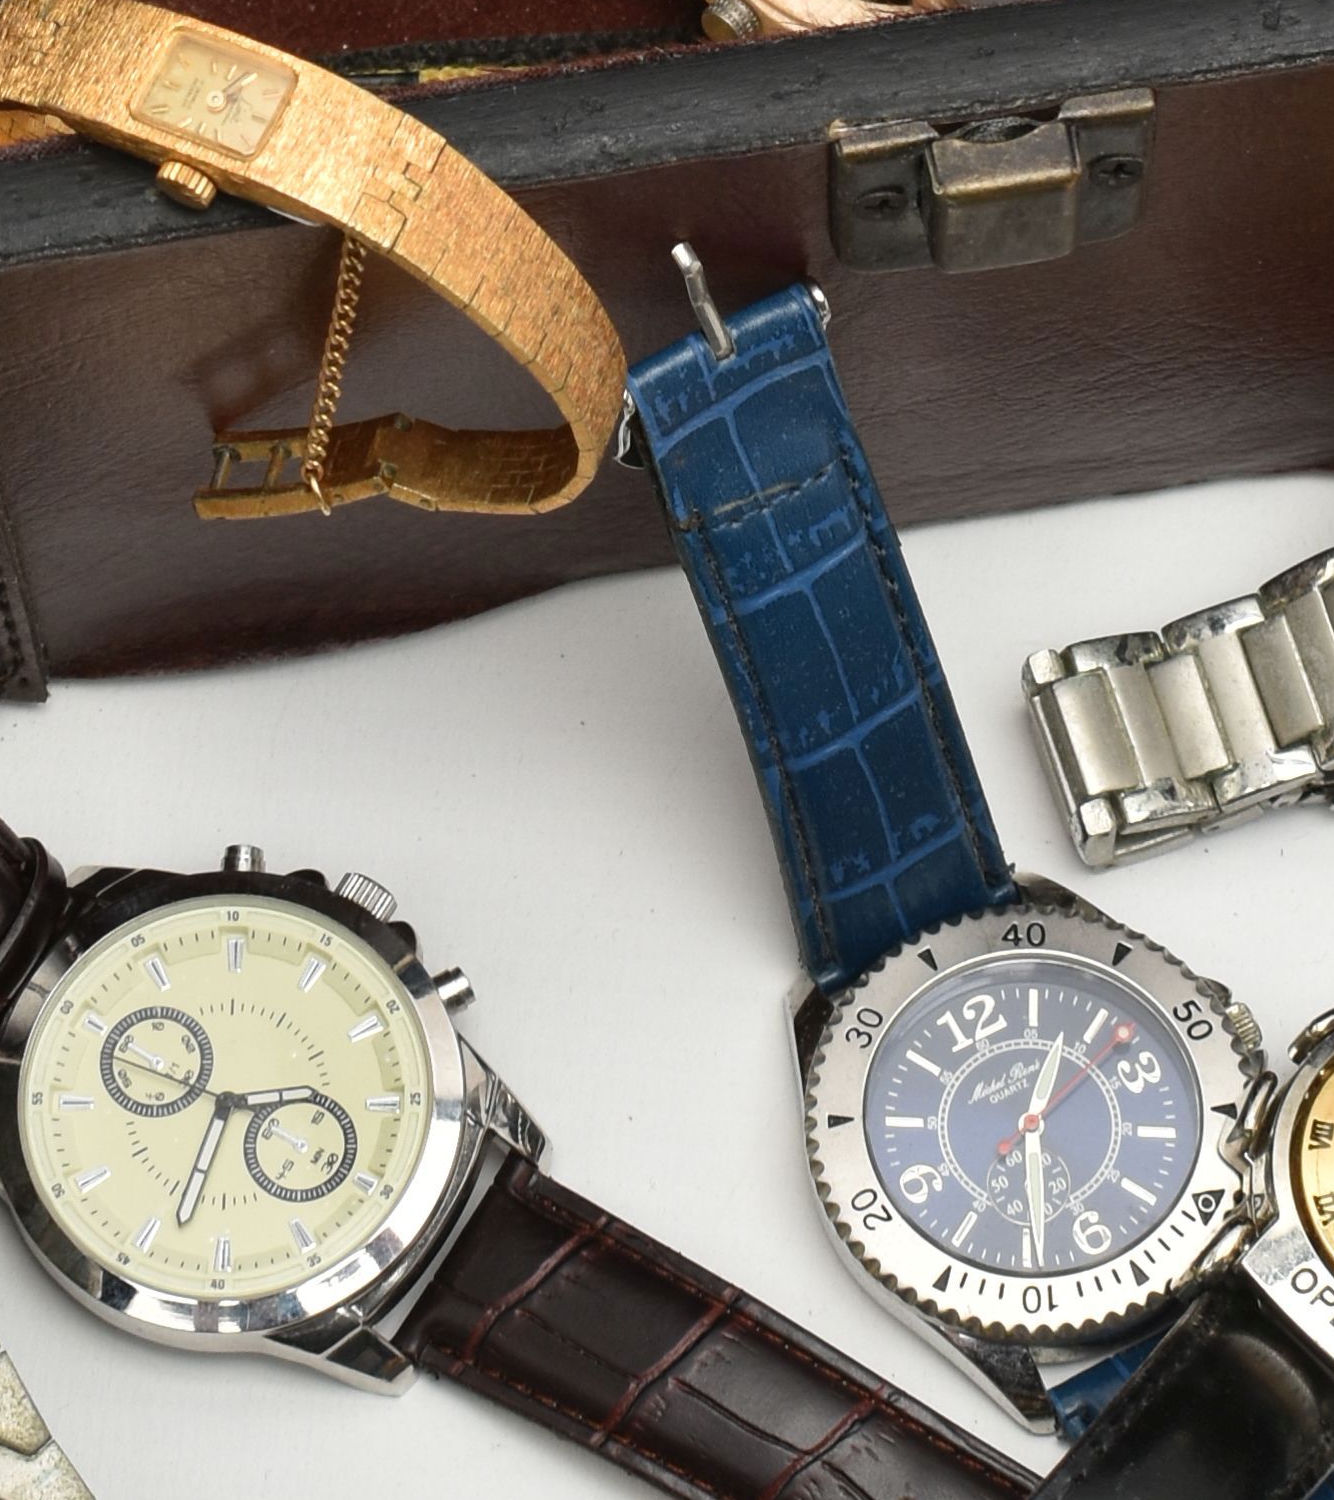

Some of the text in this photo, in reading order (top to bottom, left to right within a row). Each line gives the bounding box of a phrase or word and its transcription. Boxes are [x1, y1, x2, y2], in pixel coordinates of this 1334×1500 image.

[227, 911, 240, 922] 10
[131, 932, 147, 948] 05
[318, 932, 333, 948] 15
[1002, 922, 1047, 947] 40
[60, 998, 74, 1015] 00
[385, 998, 401, 1015] 20
[845, 1007, 885, 1050] 30
[936, 992, 1008, 1054] 12
[1172, 998, 1214, 1042] 50
[1023, 1027, 1038, 1041] 05
[1116, 1050, 1163, 1095] 3
[31, 1090, 43, 1107] 55
[410, 1090, 422, 1106] 25
[988, 1078, 1031, 1104] QUARTZ
[1003, 1151, 1024, 1169] 60
[50, 1182, 66, 1200] 50
[378, 1184, 395, 1201] 30
[899, 1161, 945, 1206] 9
[990, 1176, 1008, 1194] 50
[1048, 1177, 1067, 1194] 20
[850, 1187, 892, 1233] 20
[1005, 1199, 1025, 1217] 40
[1071, 1209, 1112, 1256] 6
[114, 1250, 132, 1266] 45
[305, 1252, 323, 1269] 35
[209, 1277, 226, 1290] 40
[1022, 1284, 1056, 1314] 10
